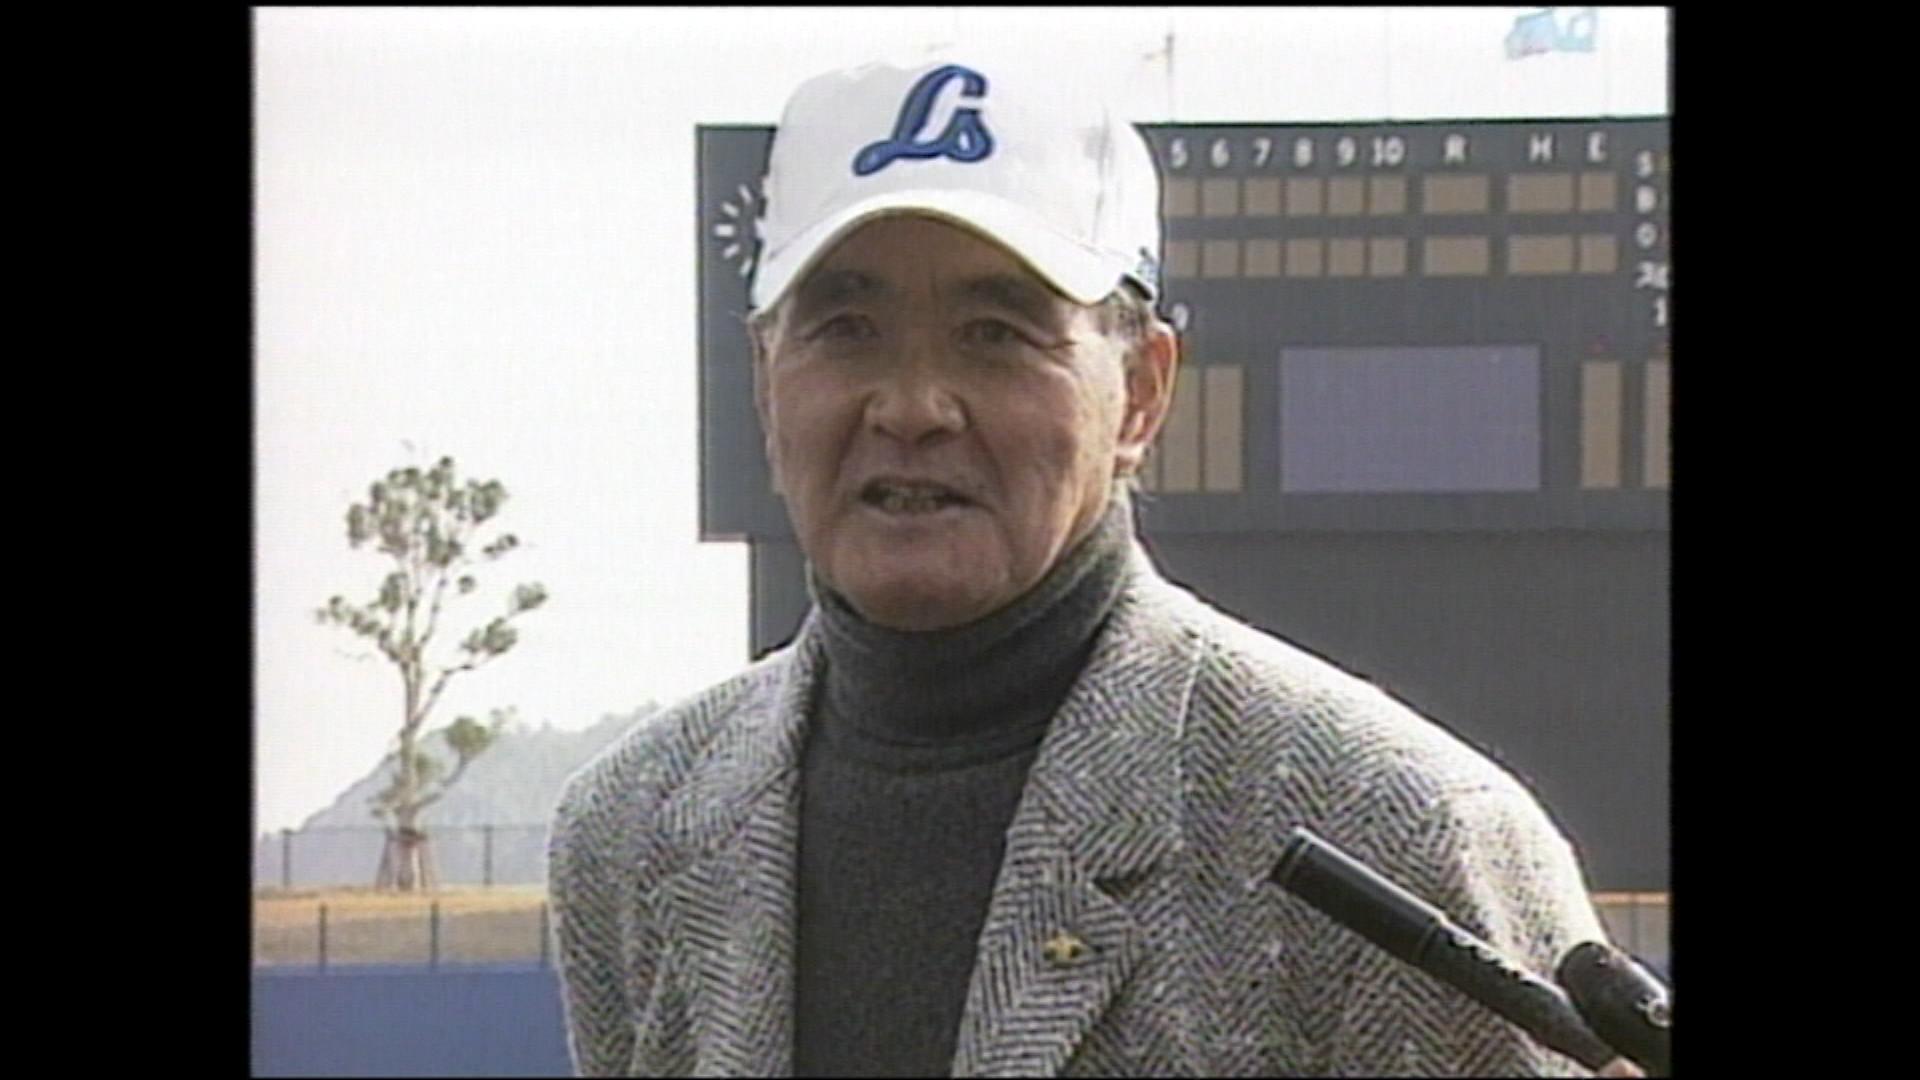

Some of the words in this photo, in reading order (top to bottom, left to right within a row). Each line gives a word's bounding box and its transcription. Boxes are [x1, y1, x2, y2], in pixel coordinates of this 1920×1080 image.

[1172, 138, 1188, 168] 5
[1211, 138, 1229, 167] 6
[1253, 138, 1271, 167] 7
[1295, 137, 1312, 167] 8
[1337, 136, 1355, 166] 9
[1373, 136, 1404, 166] 10
[1445, 134, 1466, 164] R
[1530, 132, 1551, 162] H
[1588, 131, 1607, 162] E
